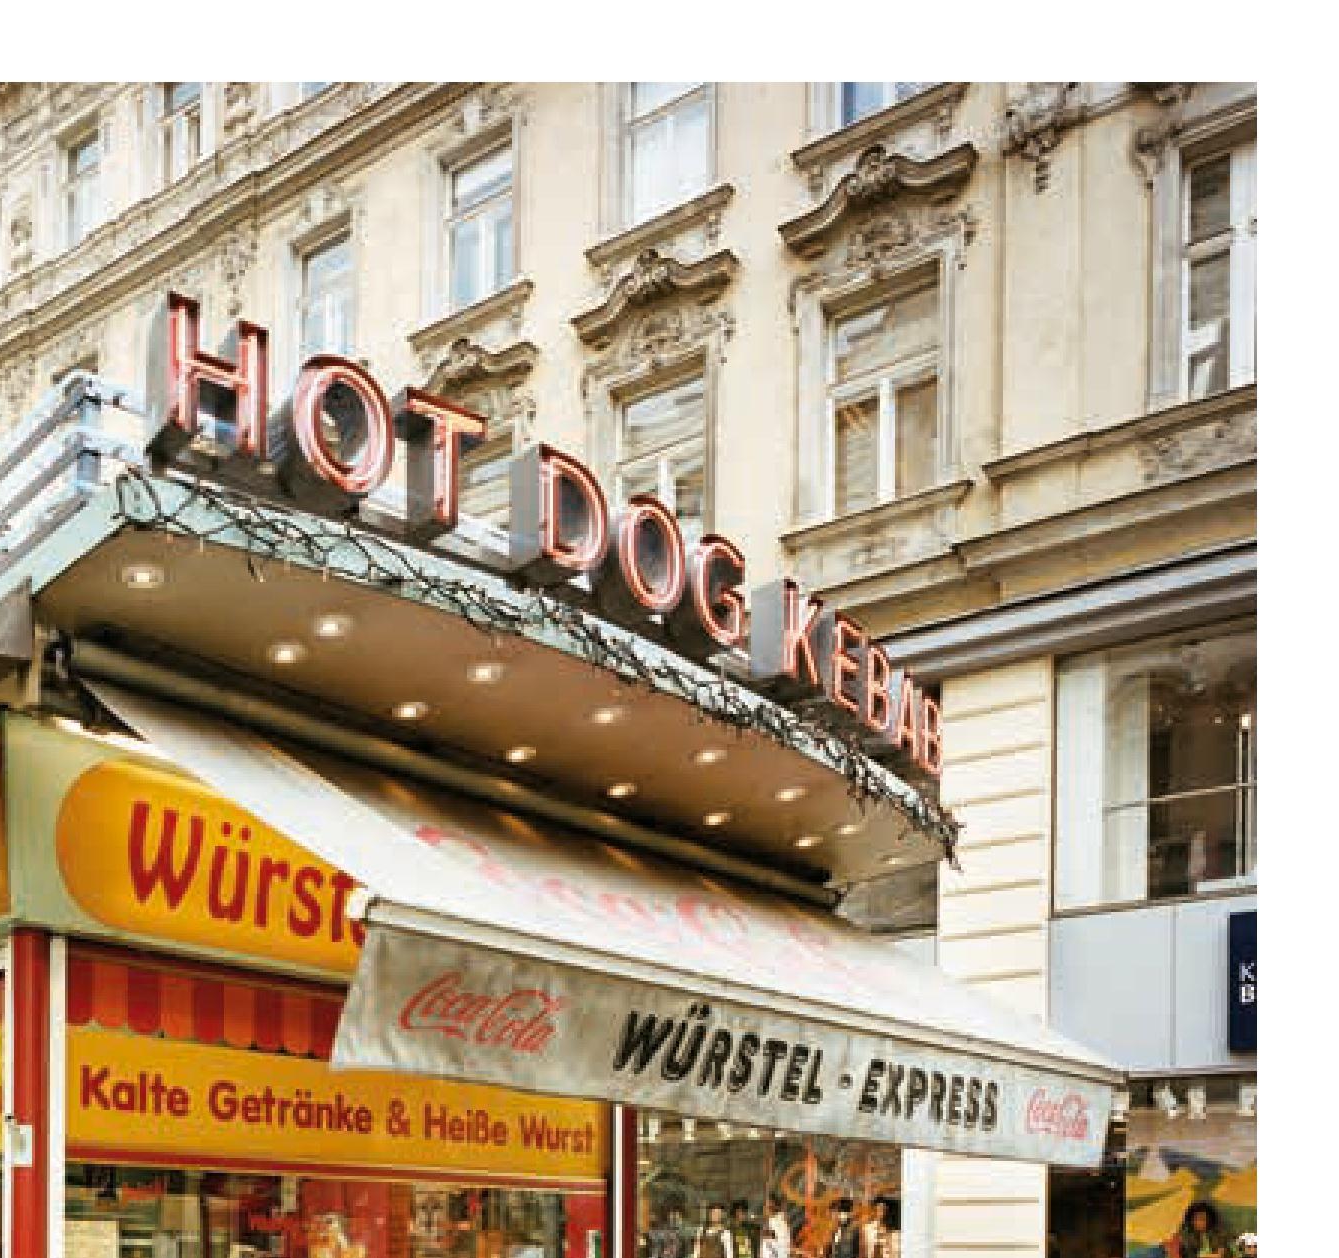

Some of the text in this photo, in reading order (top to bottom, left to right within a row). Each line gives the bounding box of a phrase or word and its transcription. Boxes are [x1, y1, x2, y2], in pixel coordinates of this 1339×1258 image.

[166, 293, 943, 777] HOT DOG KEBAB
[80, 1065, 594, 1155] Kalte Getränke & Heiße Wurst
[612, 1004, 825, 1105] WÜRSTEL
[857, 1058, 1000, 1133] EXPRESS
